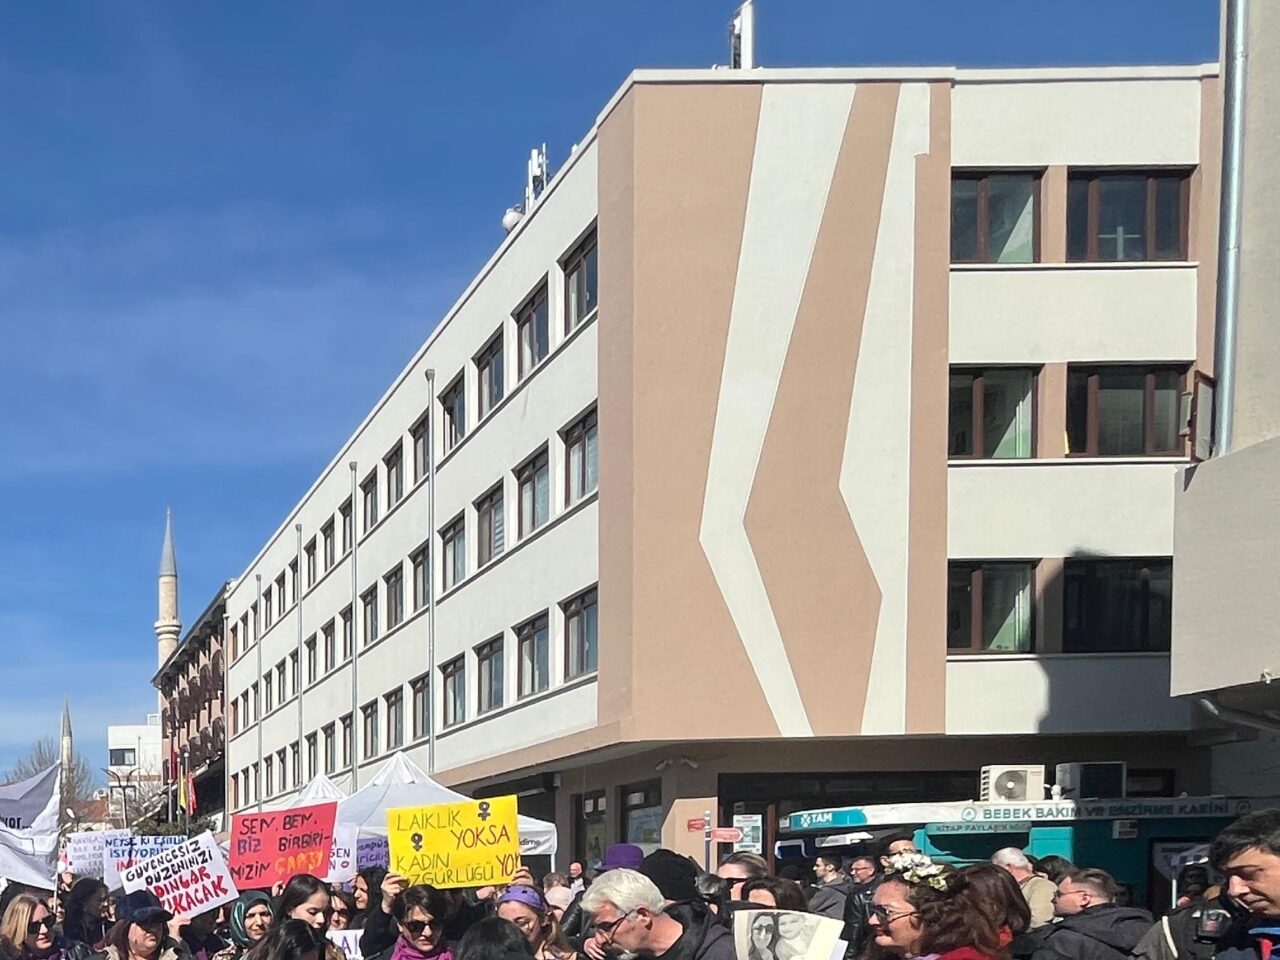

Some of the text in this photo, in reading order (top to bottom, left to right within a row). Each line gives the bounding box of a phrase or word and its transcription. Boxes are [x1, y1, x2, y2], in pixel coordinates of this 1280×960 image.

[811, 812, 833, 824] TAM
[983, 808, 1032, 819] BEBEK
[1035, 806, 1081, 818] BAKIM
[450, 824, 511, 850] YOKSA
[395, 852, 451, 873] KADIN
[407, 860, 494, 887] ZGÜRLÜĞÜ
